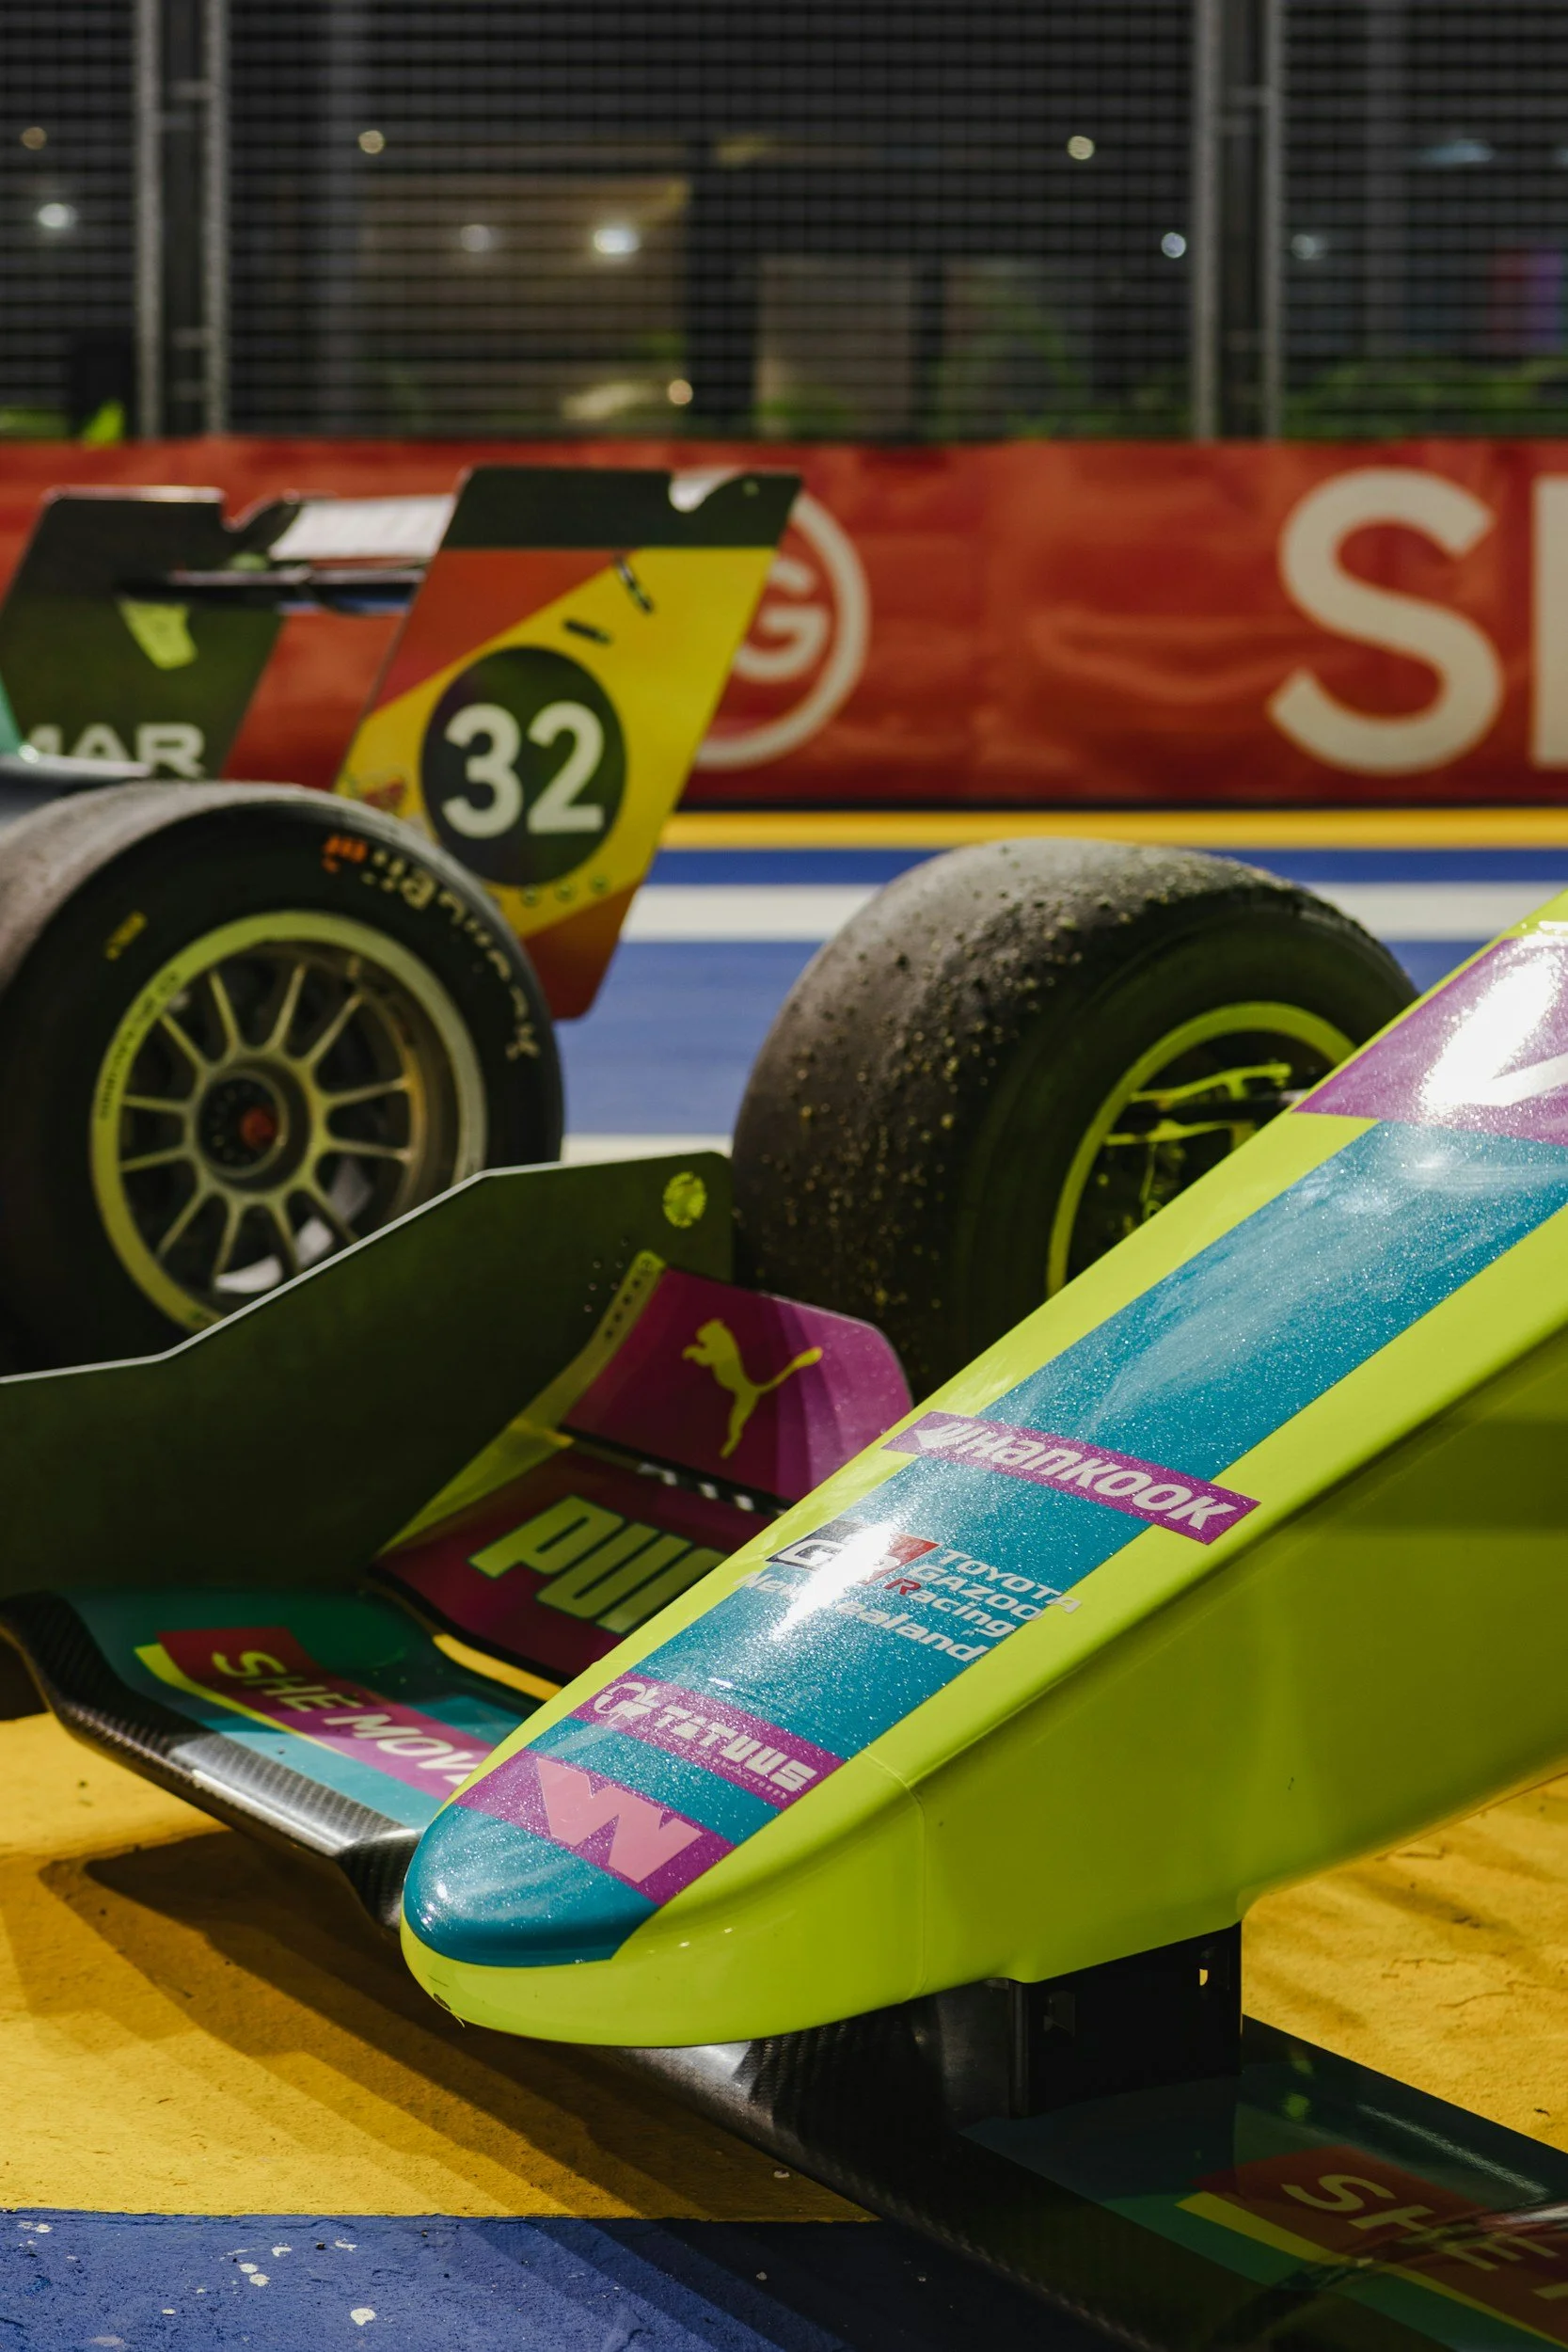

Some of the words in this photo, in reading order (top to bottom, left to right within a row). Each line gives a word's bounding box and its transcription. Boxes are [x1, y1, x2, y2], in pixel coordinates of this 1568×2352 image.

[441, 700, 605, 839] 32
[882, 1577, 1018, 1638] Racing
[906, 1564, 1045, 1621] GAZOO
[937, 1549, 1082, 1614] TOYOTA
[732, 1570, 800, 1597] Ne
[835, 1601, 990, 1662] ealand
[212, 1650, 365, 1712] SHE
[324, 1713, 484, 1787] MOV
